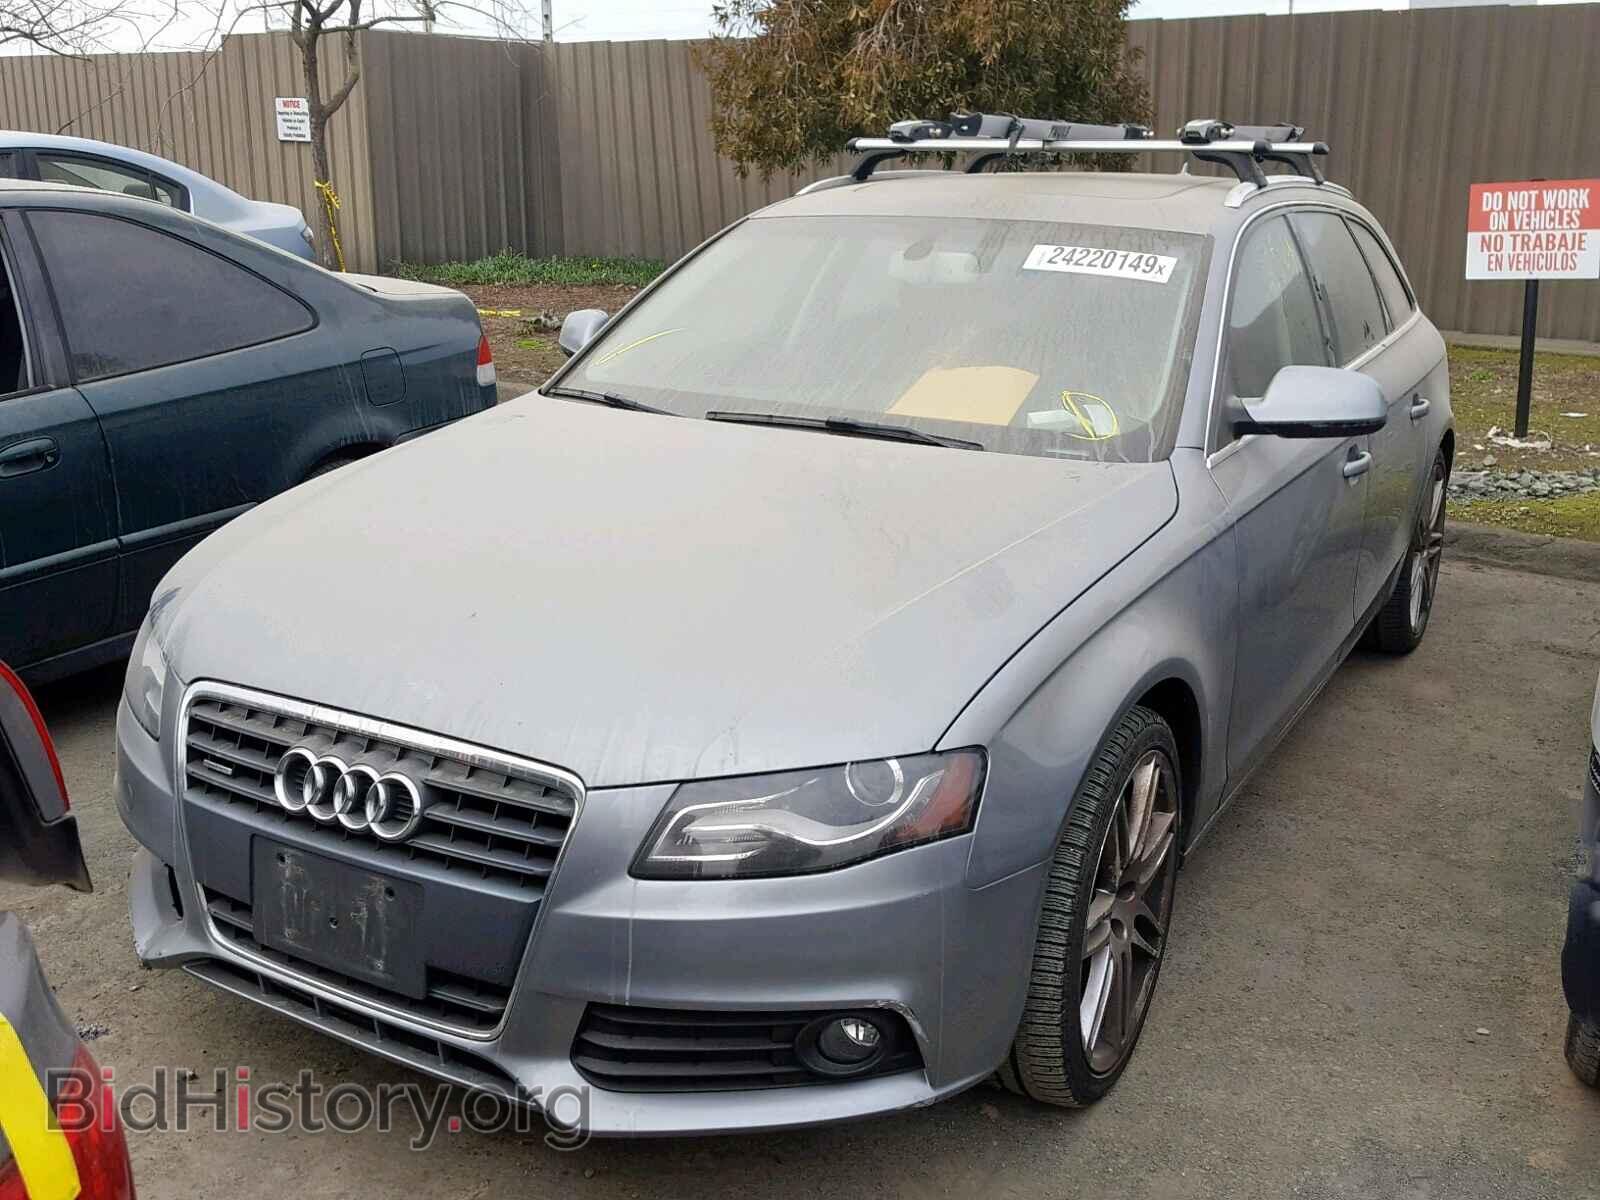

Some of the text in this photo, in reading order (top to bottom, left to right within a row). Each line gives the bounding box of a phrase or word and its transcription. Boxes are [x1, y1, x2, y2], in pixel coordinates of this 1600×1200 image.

[282, 100, 301, 109] NOTICE
[1482, 188, 1590, 211] DO NOT WORK
[1489, 209, 1581, 231] ON VEHICLES
[1480, 232, 1587, 252] NO TRABAJE
[1487, 252, 1577, 272] EN VEHICULOS
